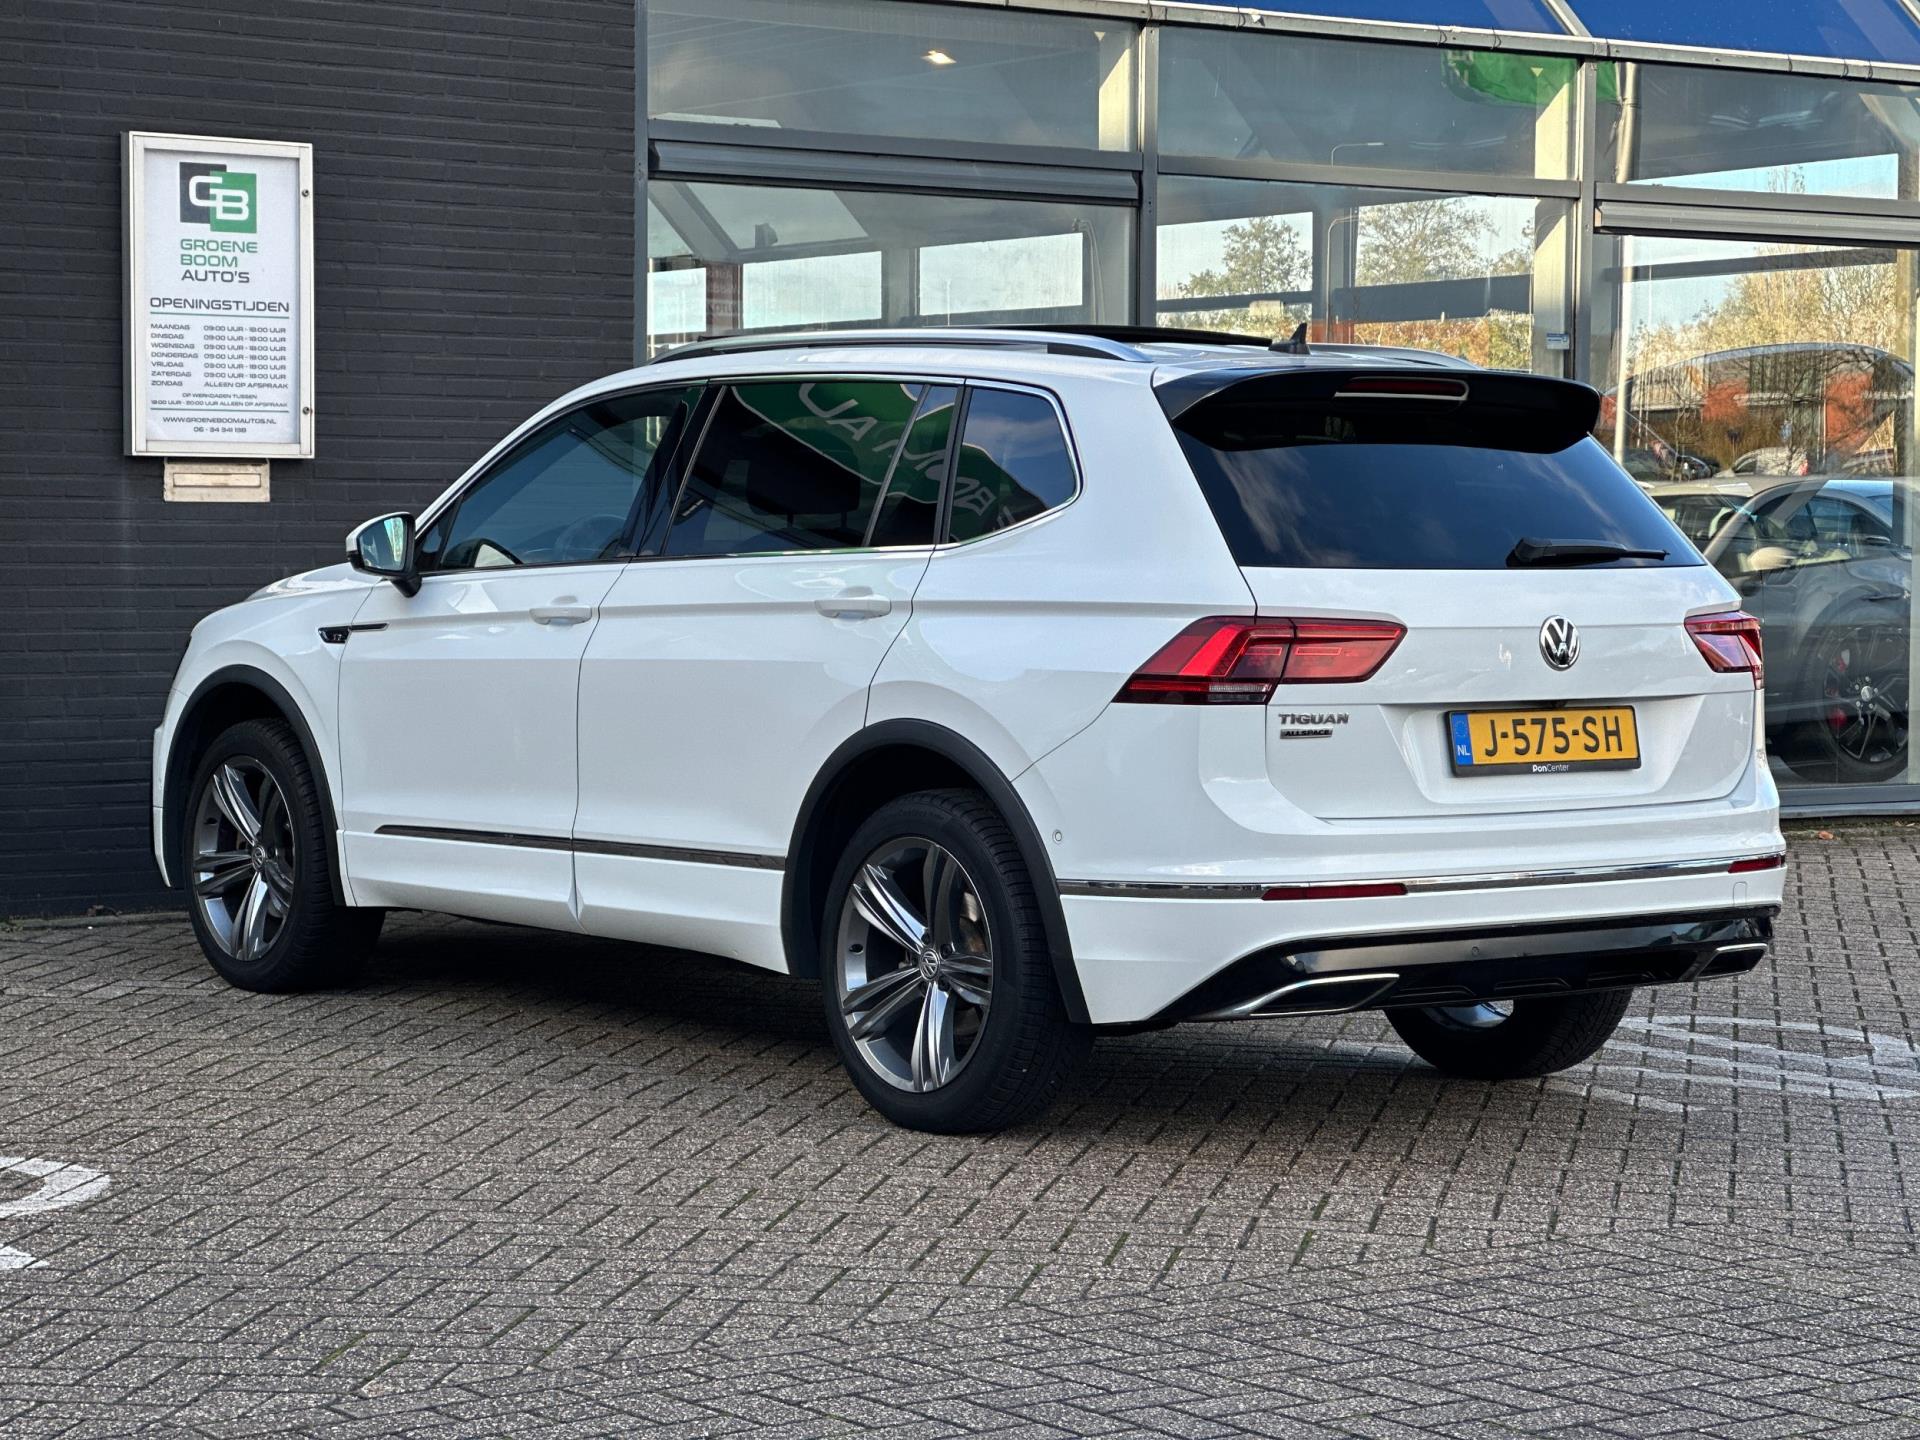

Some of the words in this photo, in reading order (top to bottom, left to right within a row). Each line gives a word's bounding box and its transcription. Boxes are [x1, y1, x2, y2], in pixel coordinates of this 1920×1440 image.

[180, 238, 258, 253] GROENE
[180, 254, 238, 267] BOOM
[181, 269, 250, 283] AUTO'S
[150, 297, 290, 312] OPENINGSTIJDEN
[1278, 712, 1349, 725] TIGUAN
[1284, 729, 1331, 737] ALLSPACE
[1484, 716, 1623, 757] J-575-SH
[1457, 745, 1471, 757] NL
